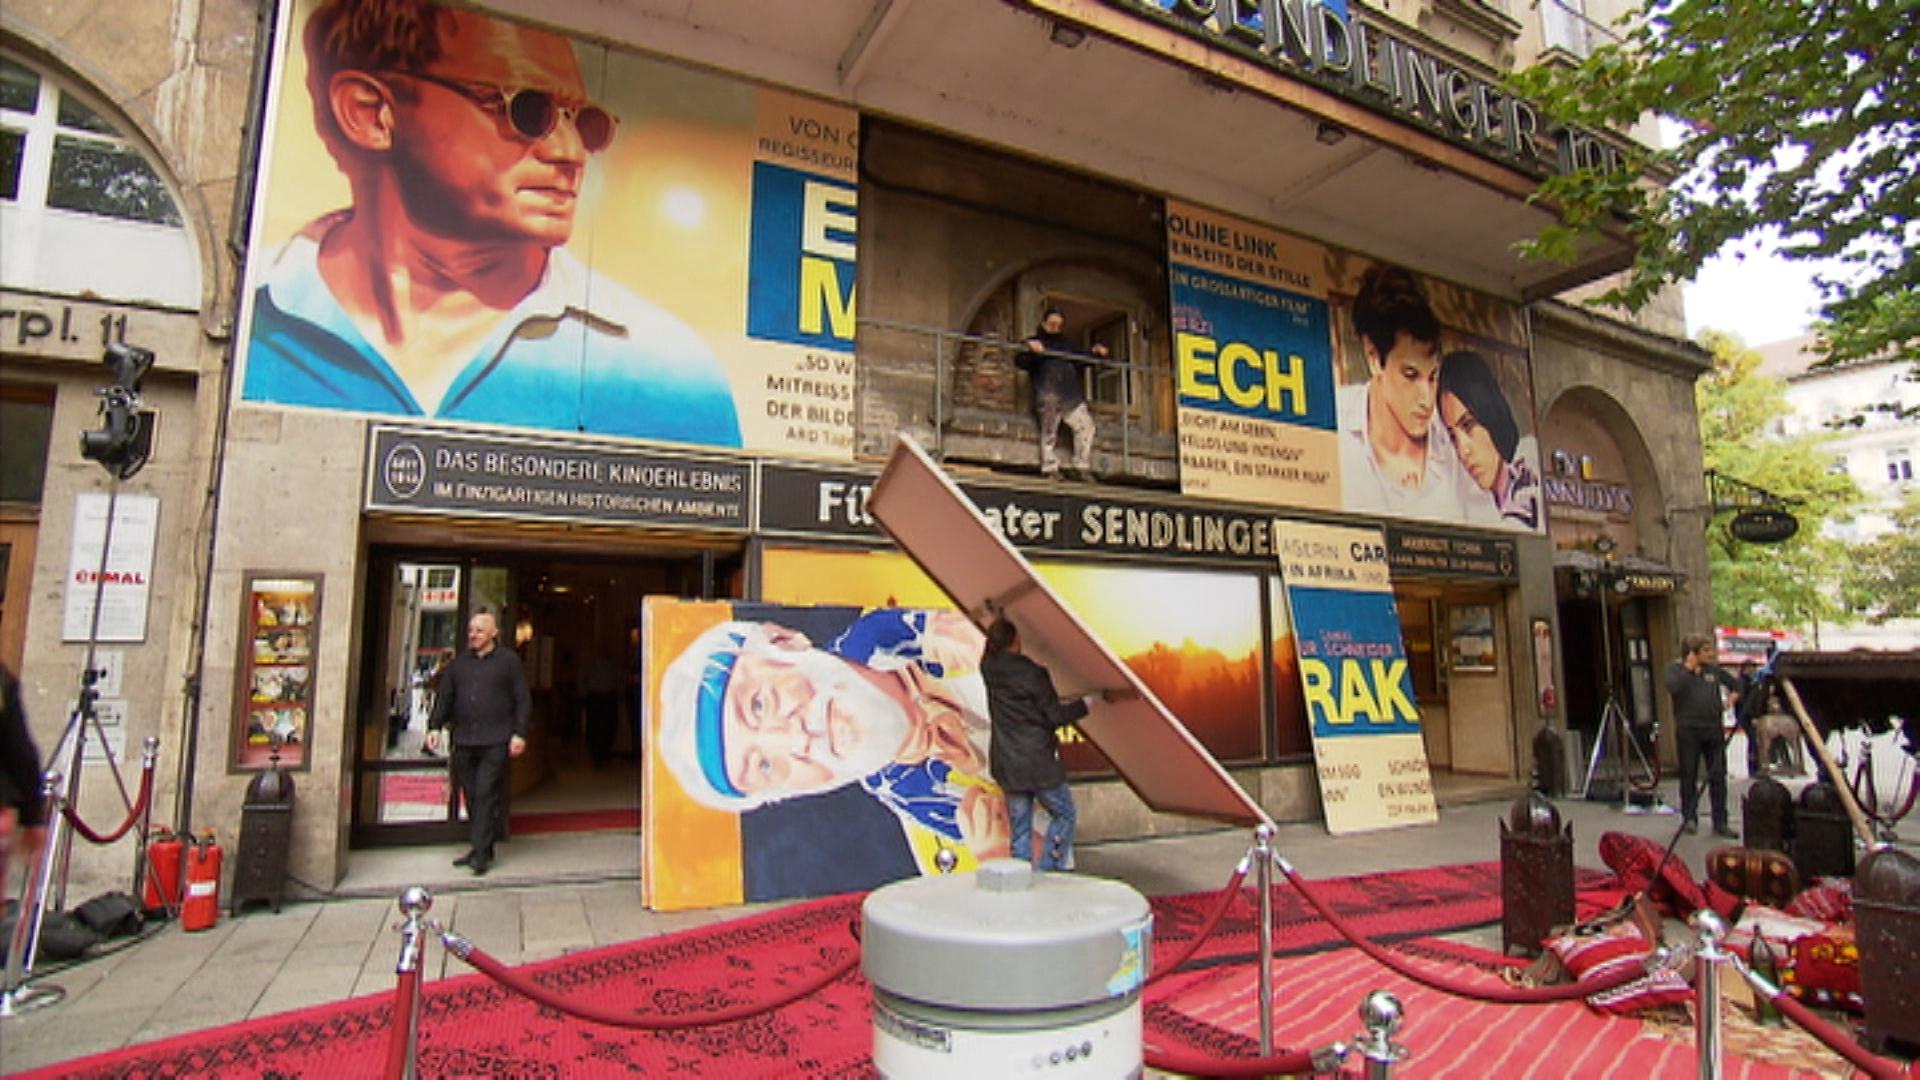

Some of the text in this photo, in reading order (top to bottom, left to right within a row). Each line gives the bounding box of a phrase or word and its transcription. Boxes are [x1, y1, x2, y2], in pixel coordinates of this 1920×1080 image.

[1188, 0, 1539, 159] ENDLINGER
[789, 115, 840, 143] VON
[802, 180, 858, 261] E
[1232, 231, 1278, 261] LINK
[800, 255, 857, 340] M
[1177, 332, 1308, 416] ECH
[767, 399, 802, 419] DER
[432, 481, 451, 498] IM
[436, 447, 742, 493] DAS BESONDERE KINOERLEBNIS
[1081, 504, 1279, 554] SENDLINGE
[1300, 658, 1420, 723] RAK
